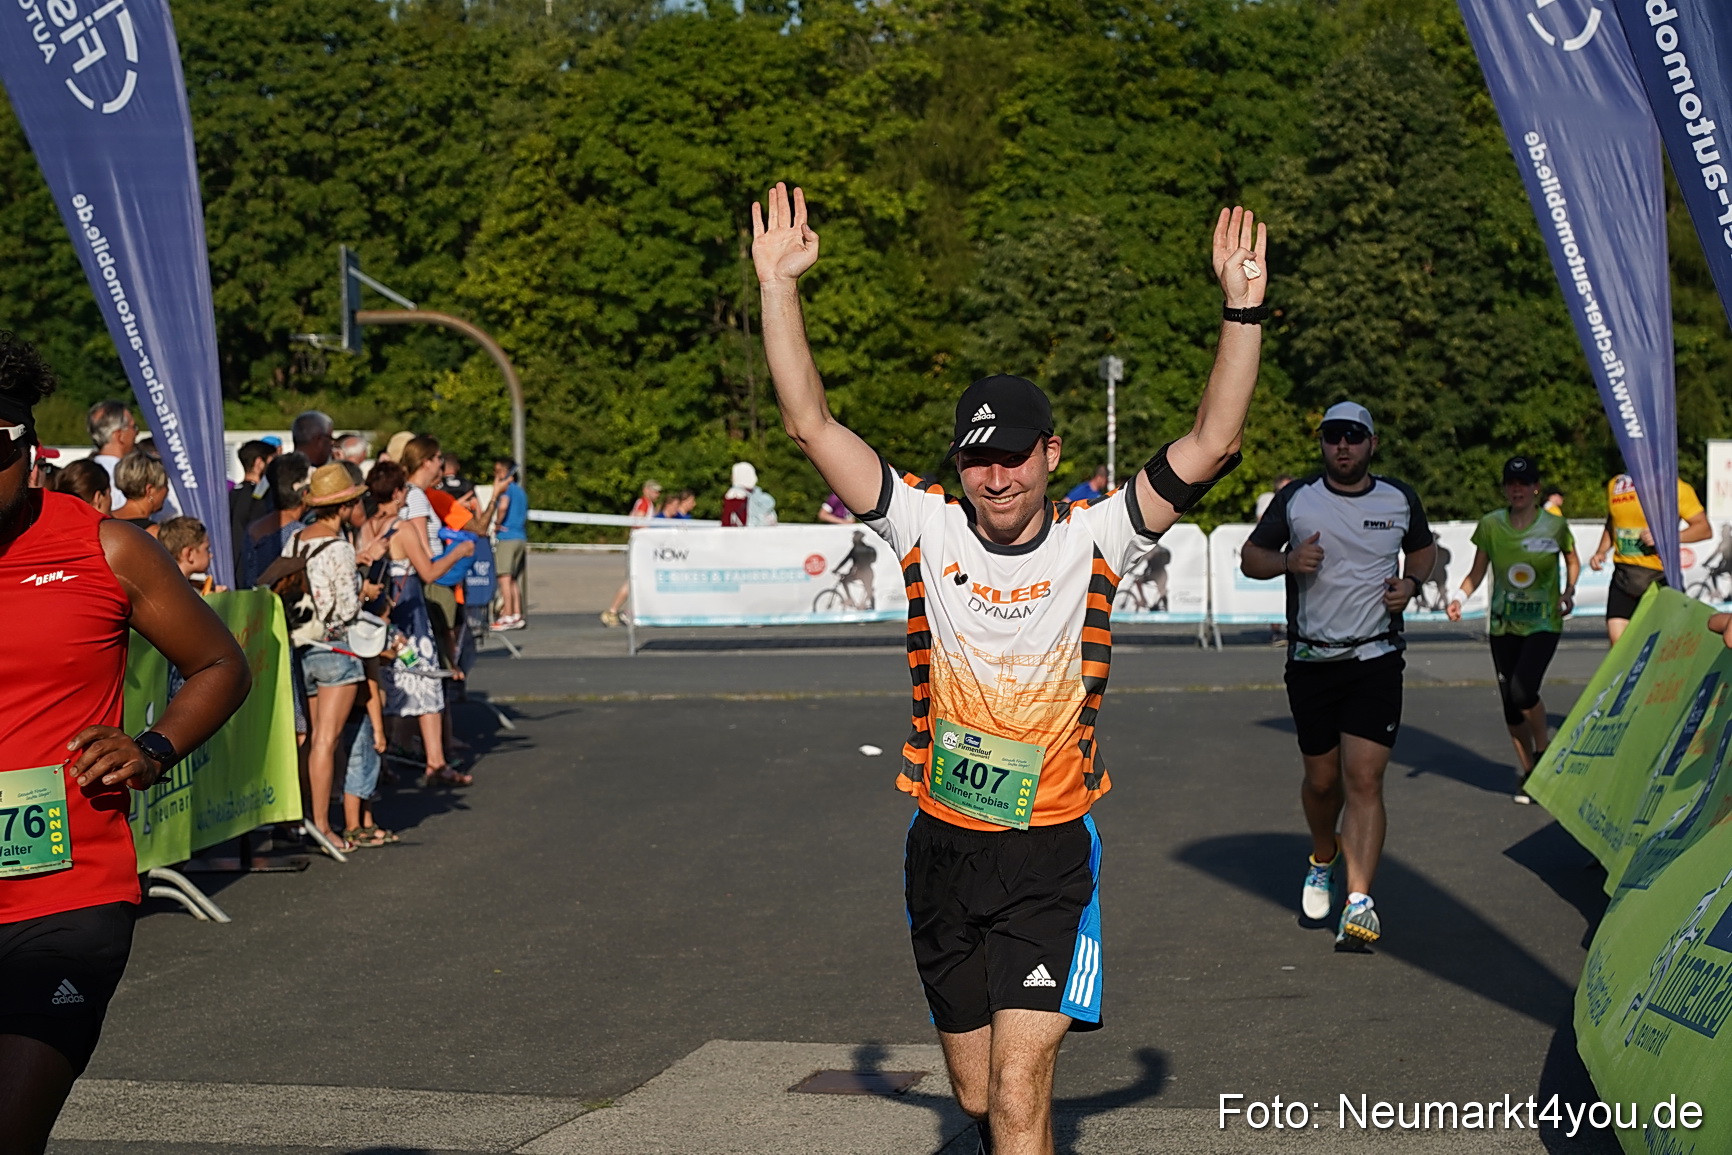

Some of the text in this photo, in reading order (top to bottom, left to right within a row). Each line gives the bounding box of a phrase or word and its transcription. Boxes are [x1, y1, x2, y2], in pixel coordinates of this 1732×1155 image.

[971, 413, 996, 423] adidas
[35, 570, 64, 586] DEHN
[935, 756, 945, 785] RUN
[951, 757, 1011, 795] 407
[945, 781, 973, 800] Dirner
[975, 792, 1010, 810] Tobias
[1015, 778, 1033, 817] 2022
[48, 807, 64, 855] 2022
[1022, 977, 1057, 988] adidas
[51, 993, 85, 1005] adidas
